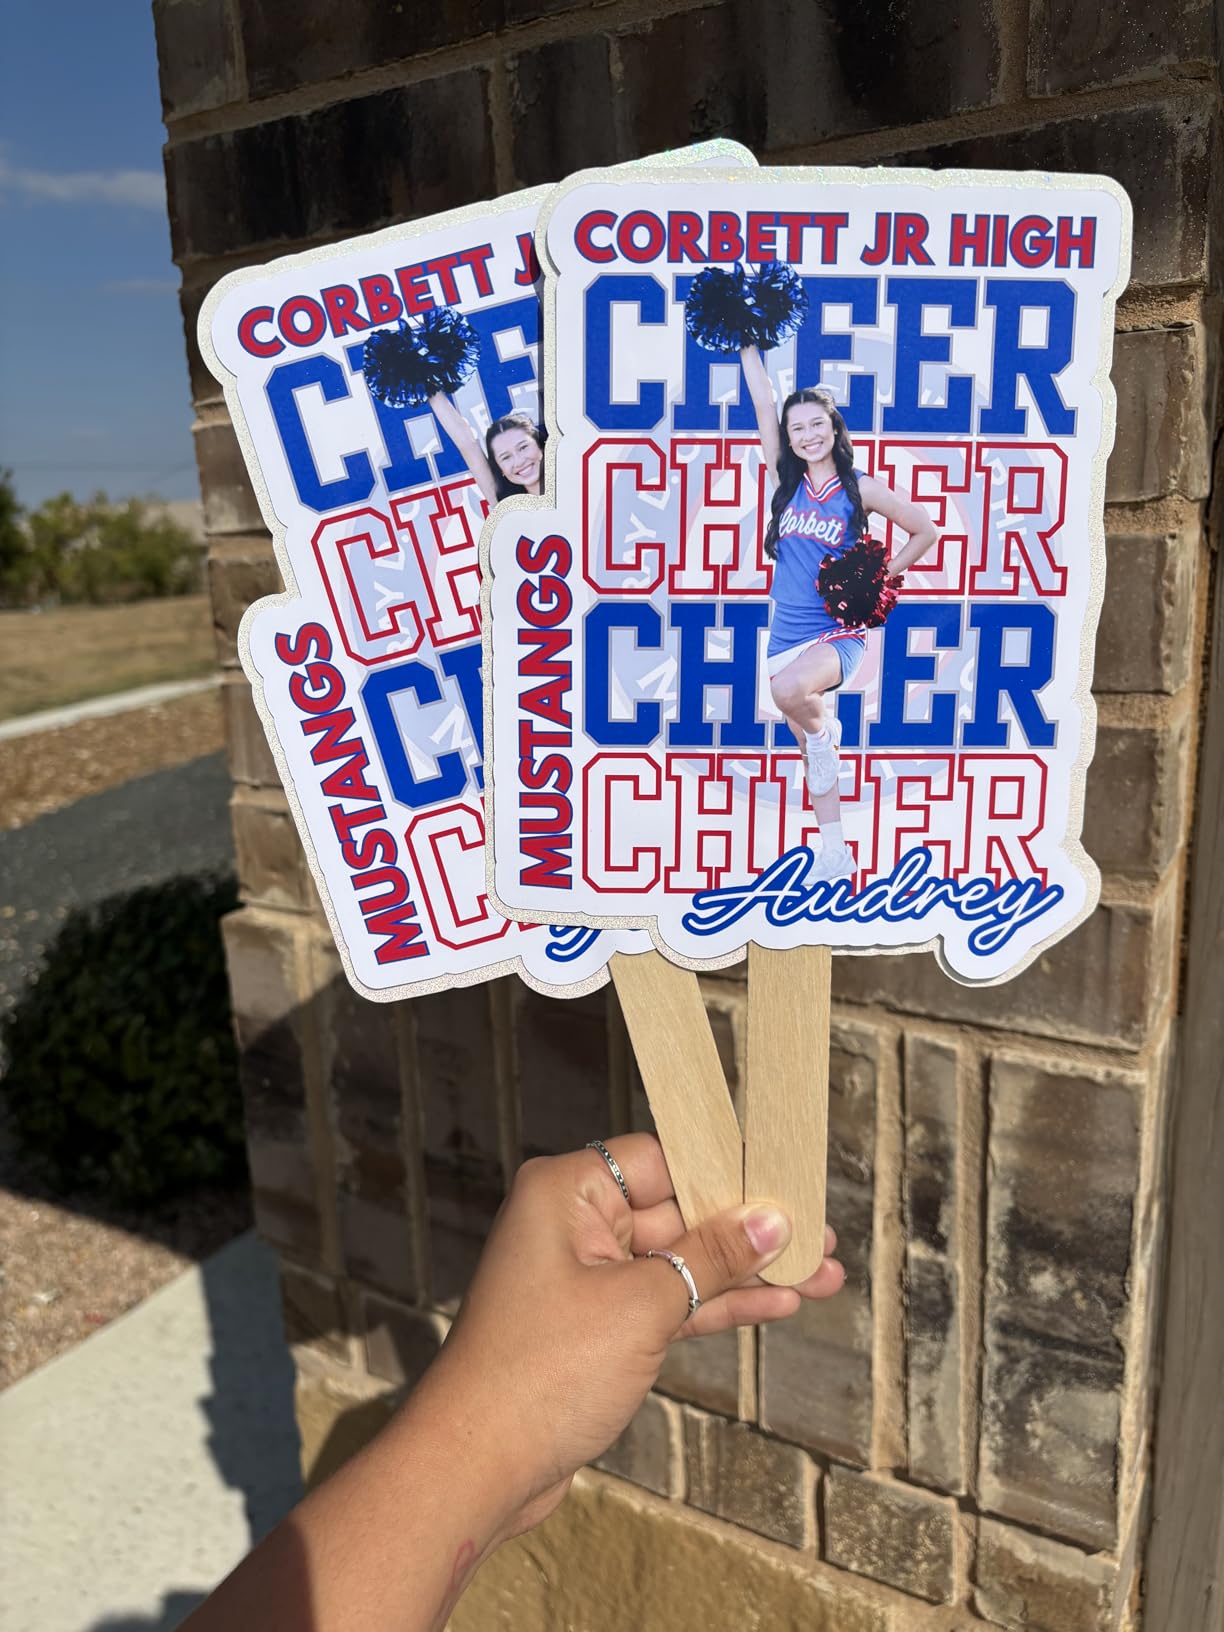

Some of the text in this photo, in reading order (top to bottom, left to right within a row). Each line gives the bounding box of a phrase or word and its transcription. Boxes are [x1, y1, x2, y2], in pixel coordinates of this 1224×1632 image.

[237, 243, 495, 358] CORBETT
[574, 209, 1097, 269] CORBETT JR HIGH
[582, 437, 1069, 597] CHER
[516, 534, 574, 890] MUSTANGS
[582, 599, 1059, 749] CHER
[274, 621, 430, 965] MUSTANGS
[682, 845, 1064, 956] Audrey
